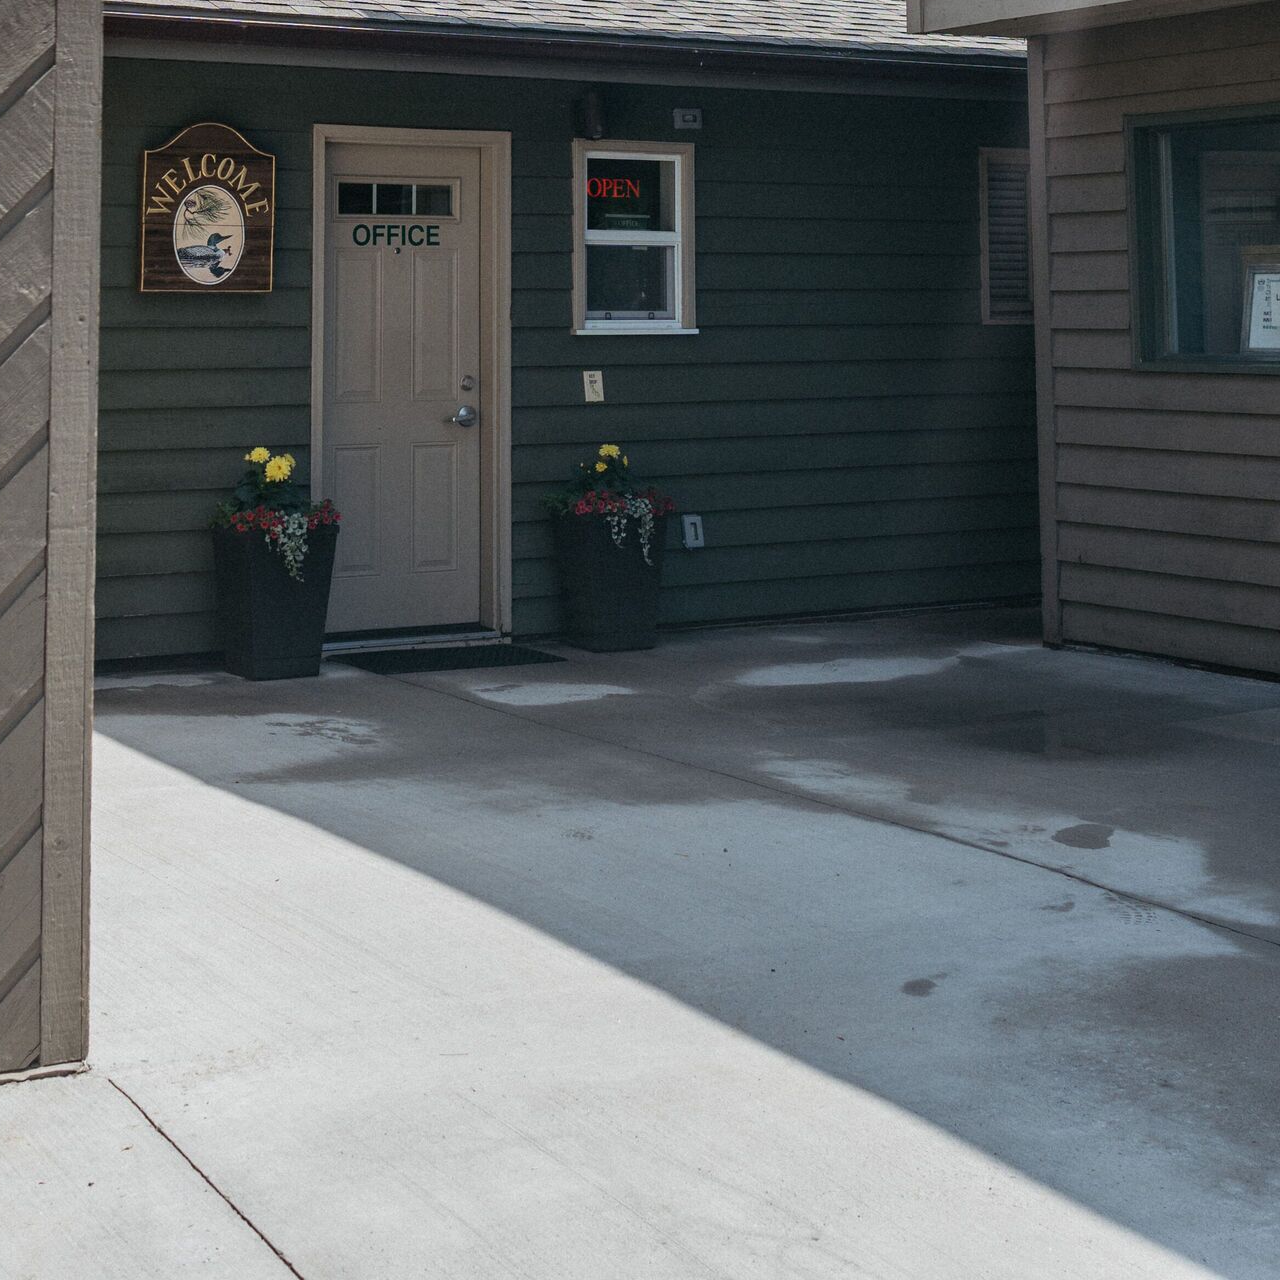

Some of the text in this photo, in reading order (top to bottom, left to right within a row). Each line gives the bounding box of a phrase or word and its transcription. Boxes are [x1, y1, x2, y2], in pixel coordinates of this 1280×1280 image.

[146, 153, 269, 218] WELCOME
[587, 178, 640, 198] OPEN
[352, 224, 440, 246] OFFICE
